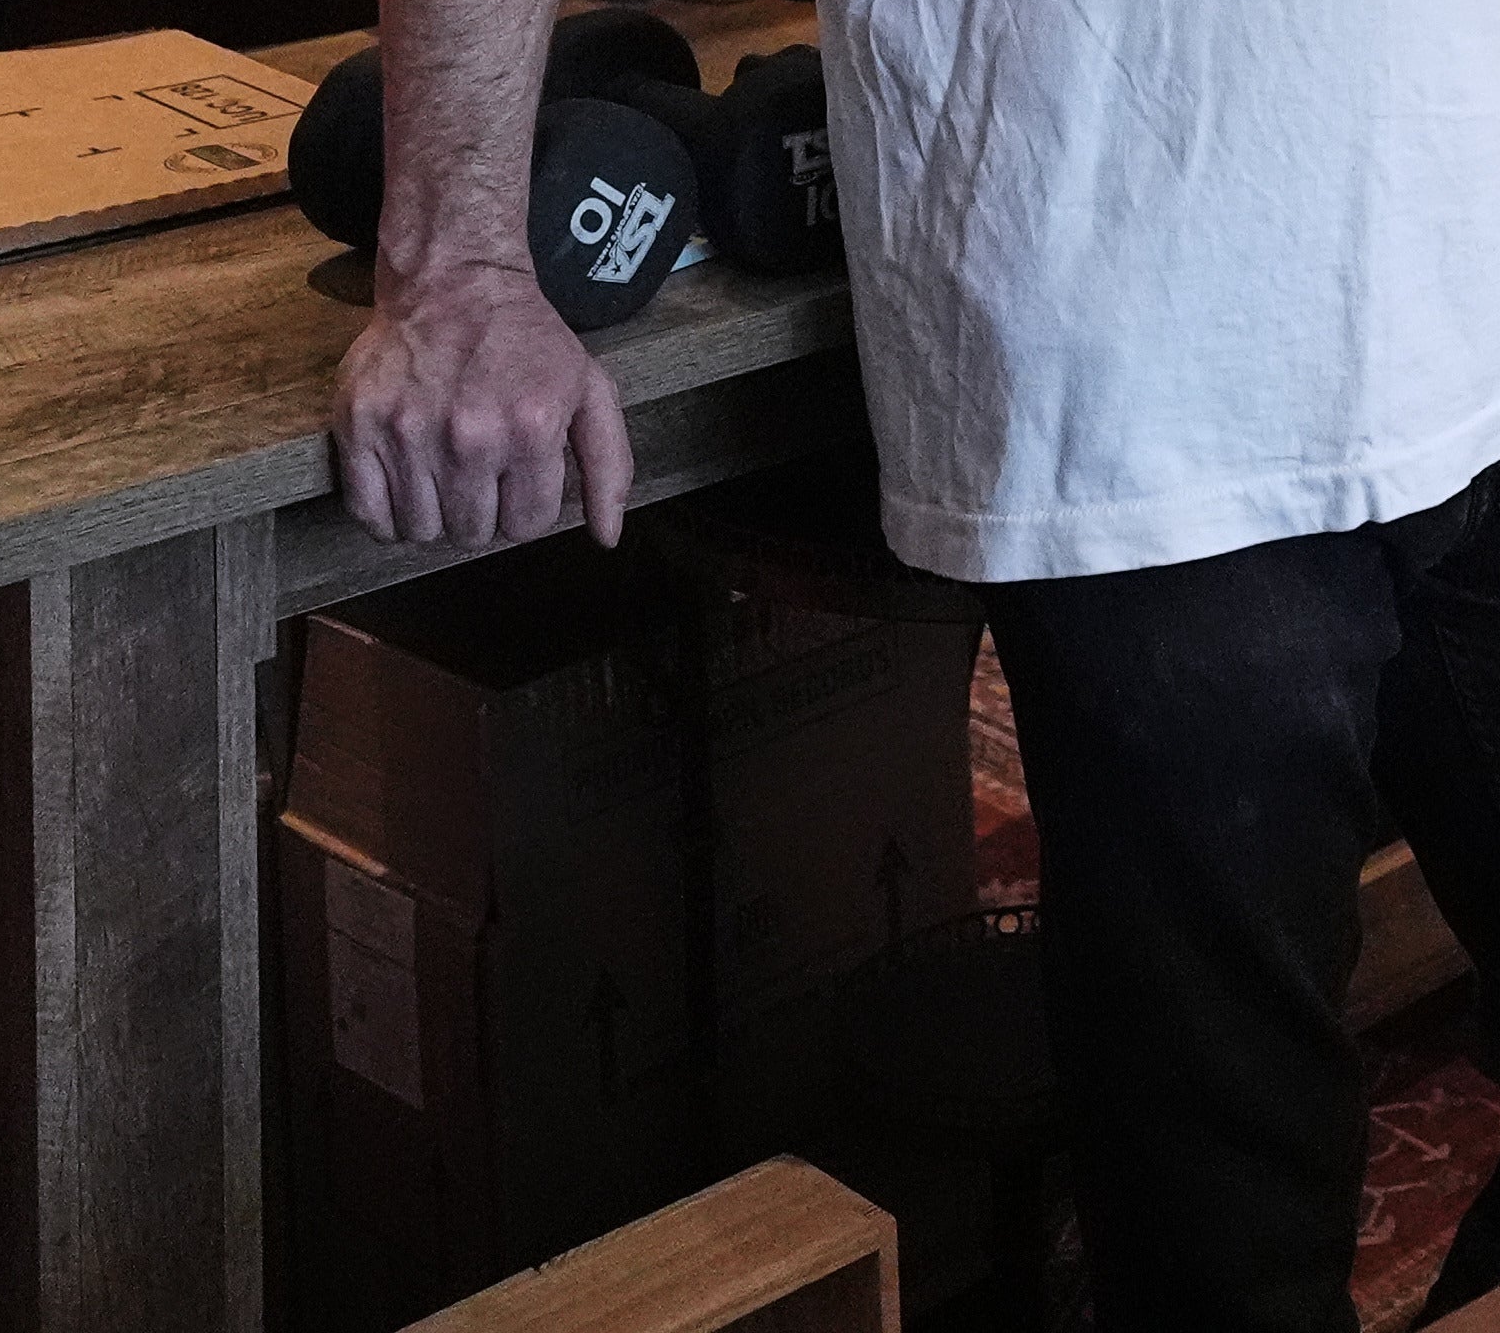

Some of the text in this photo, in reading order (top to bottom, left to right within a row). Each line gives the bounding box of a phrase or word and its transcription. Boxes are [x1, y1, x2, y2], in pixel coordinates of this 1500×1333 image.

[782, 129, 832, 175] TS
[570, 176, 627, 245] 10
[591, 189, 676, 284] TSA
